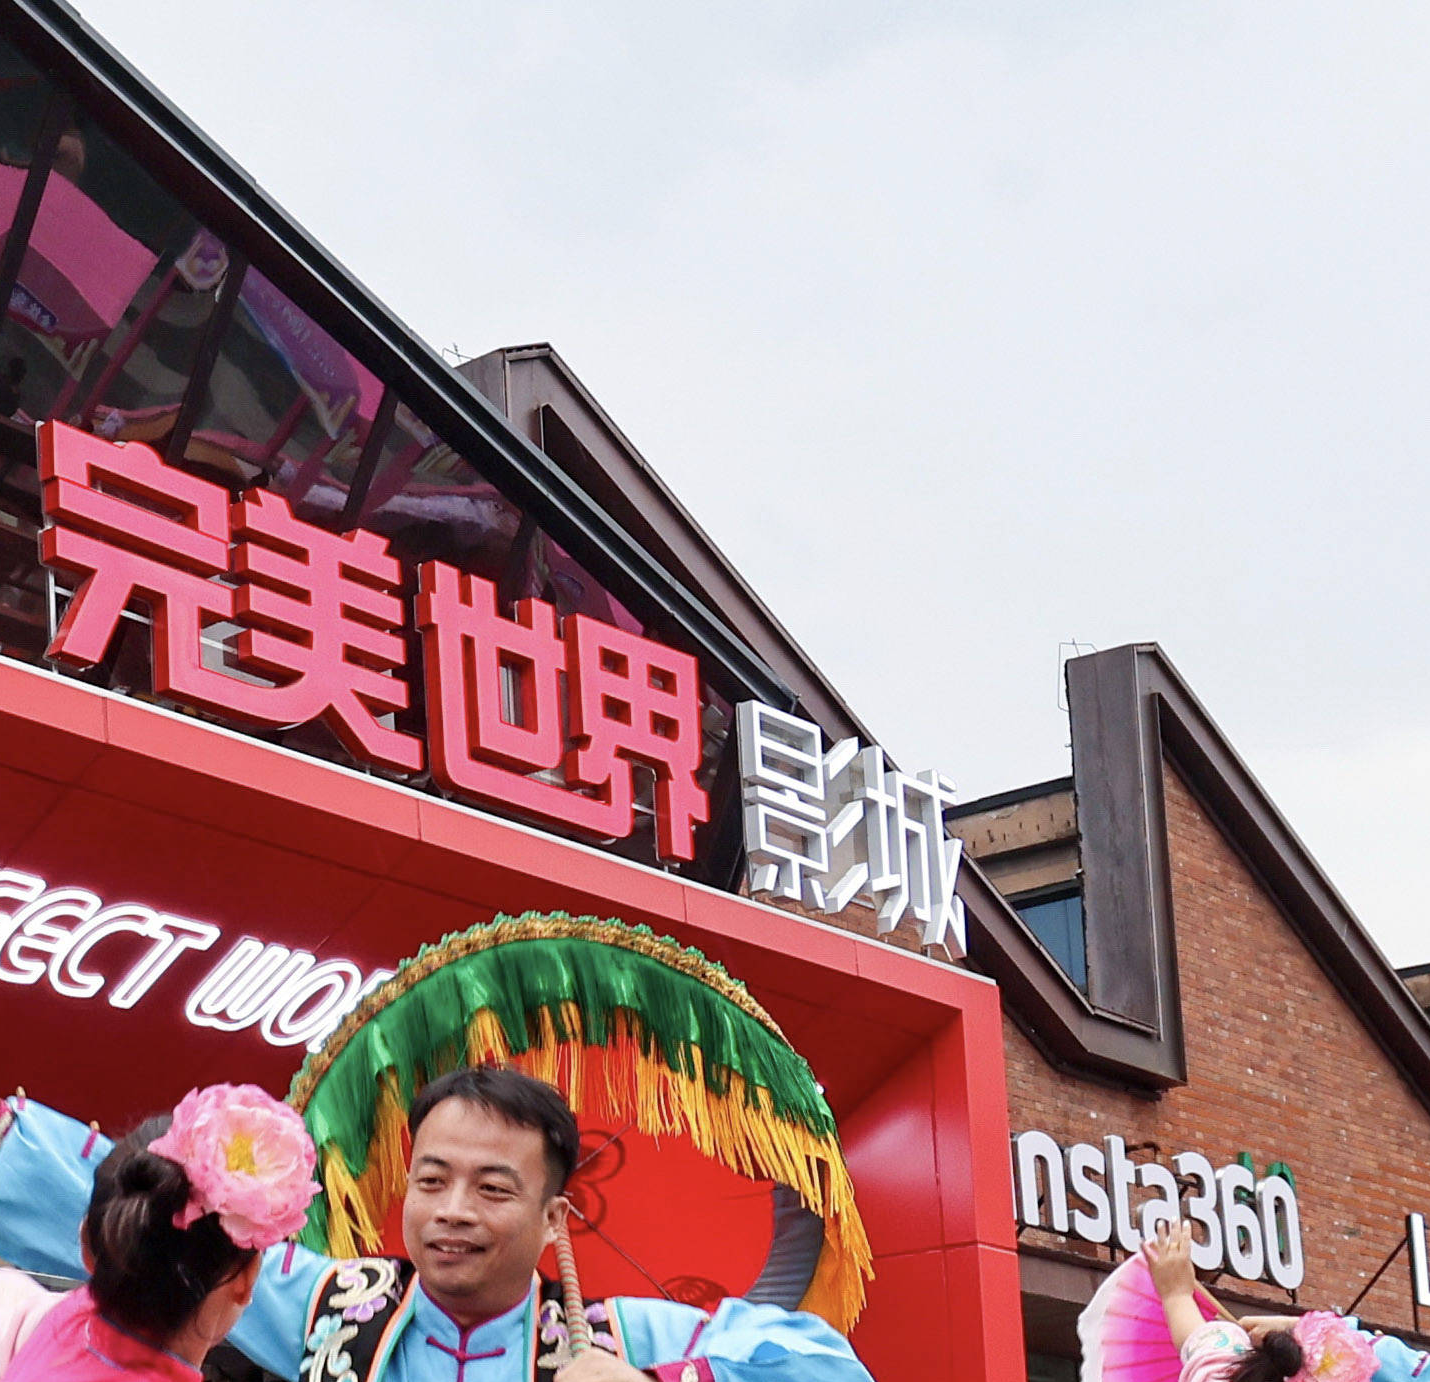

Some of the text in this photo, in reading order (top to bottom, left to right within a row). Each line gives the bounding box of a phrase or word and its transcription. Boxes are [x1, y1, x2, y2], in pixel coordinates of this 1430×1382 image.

[36, 418, 967, 958] 完美世界 影城
